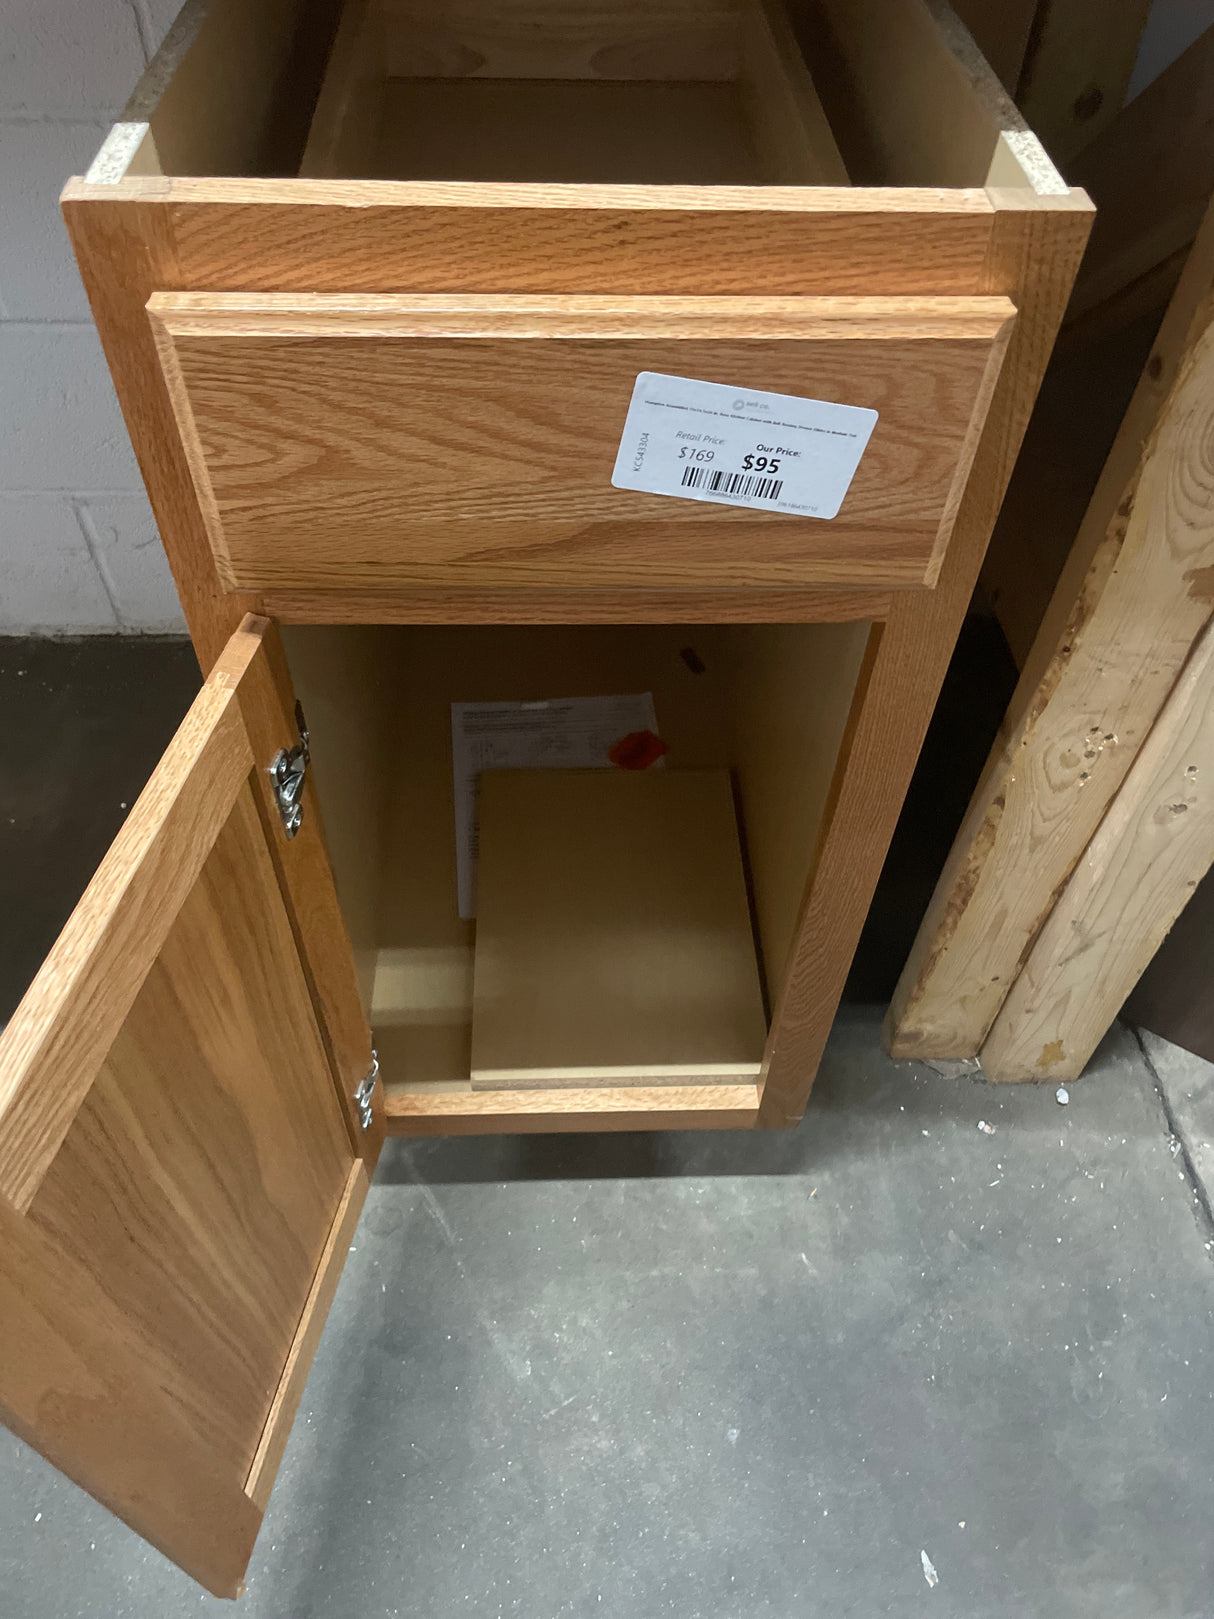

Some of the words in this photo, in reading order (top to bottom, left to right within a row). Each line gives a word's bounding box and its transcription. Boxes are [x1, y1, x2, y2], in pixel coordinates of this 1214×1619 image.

[675, 430, 701, 442] Retail
[702, 435, 727, 445] Price:
[677, 446, 715, 462] $169
[756, 443, 774, 453] Our
[775, 446, 802, 457] Price:
[741, 453, 781, 474] $95
